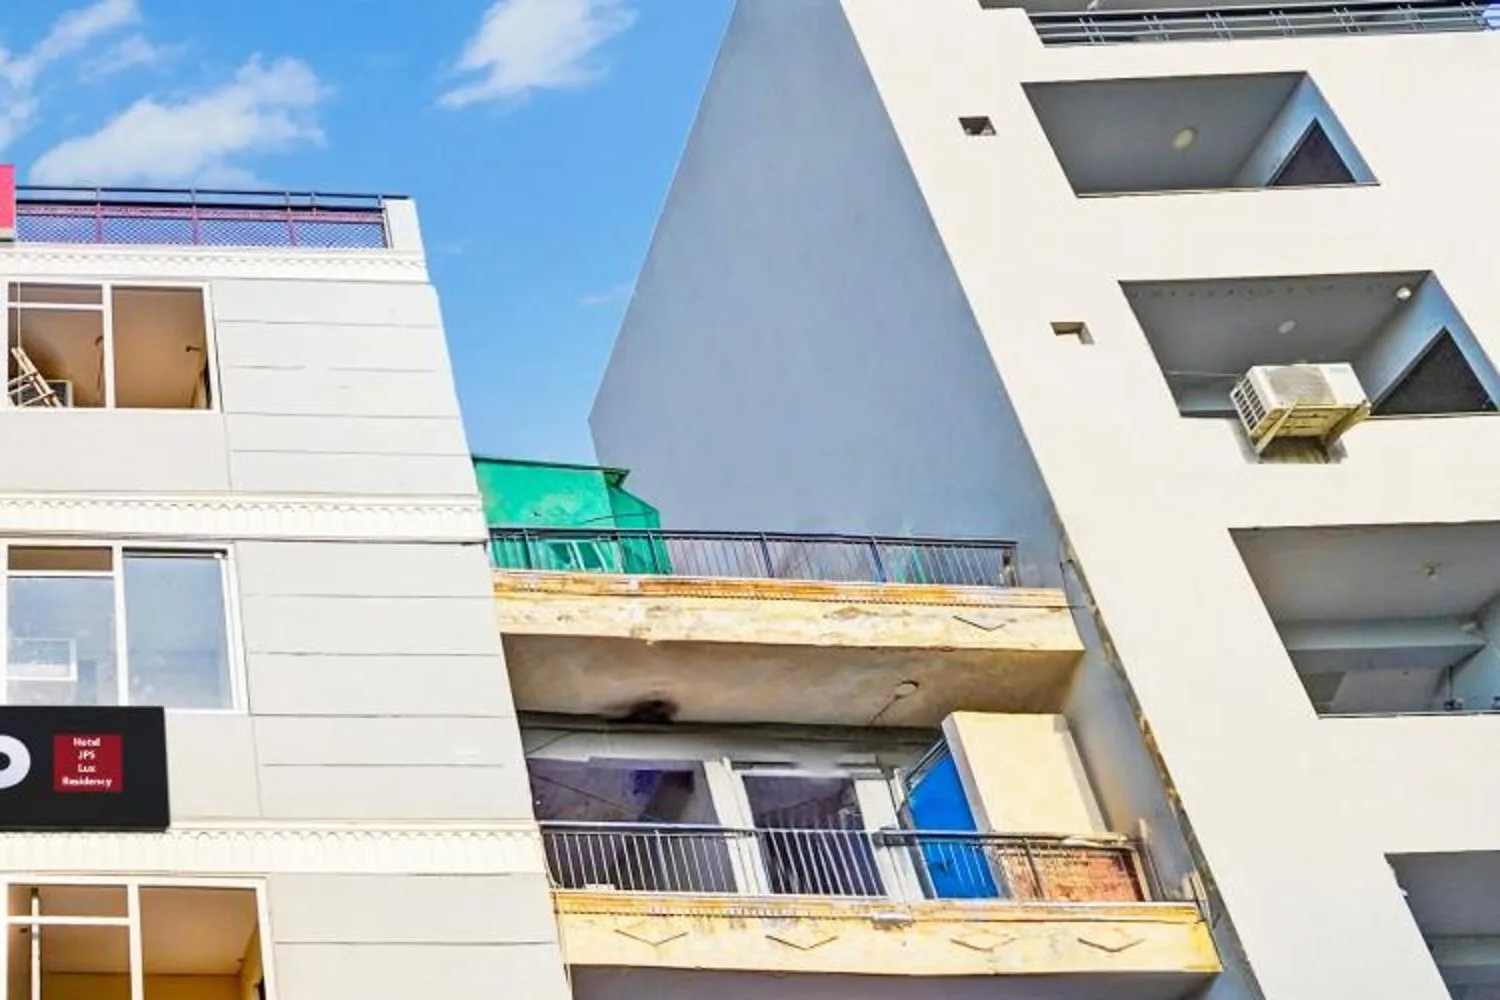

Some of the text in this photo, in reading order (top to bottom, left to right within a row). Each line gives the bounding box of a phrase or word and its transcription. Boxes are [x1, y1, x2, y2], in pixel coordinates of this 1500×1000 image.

[73, 736, 101, 747] Hotel
[78, 749, 96, 760] JPS
[77, 763, 96, 773] Lux
[61, 776, 113, 787] Residency
